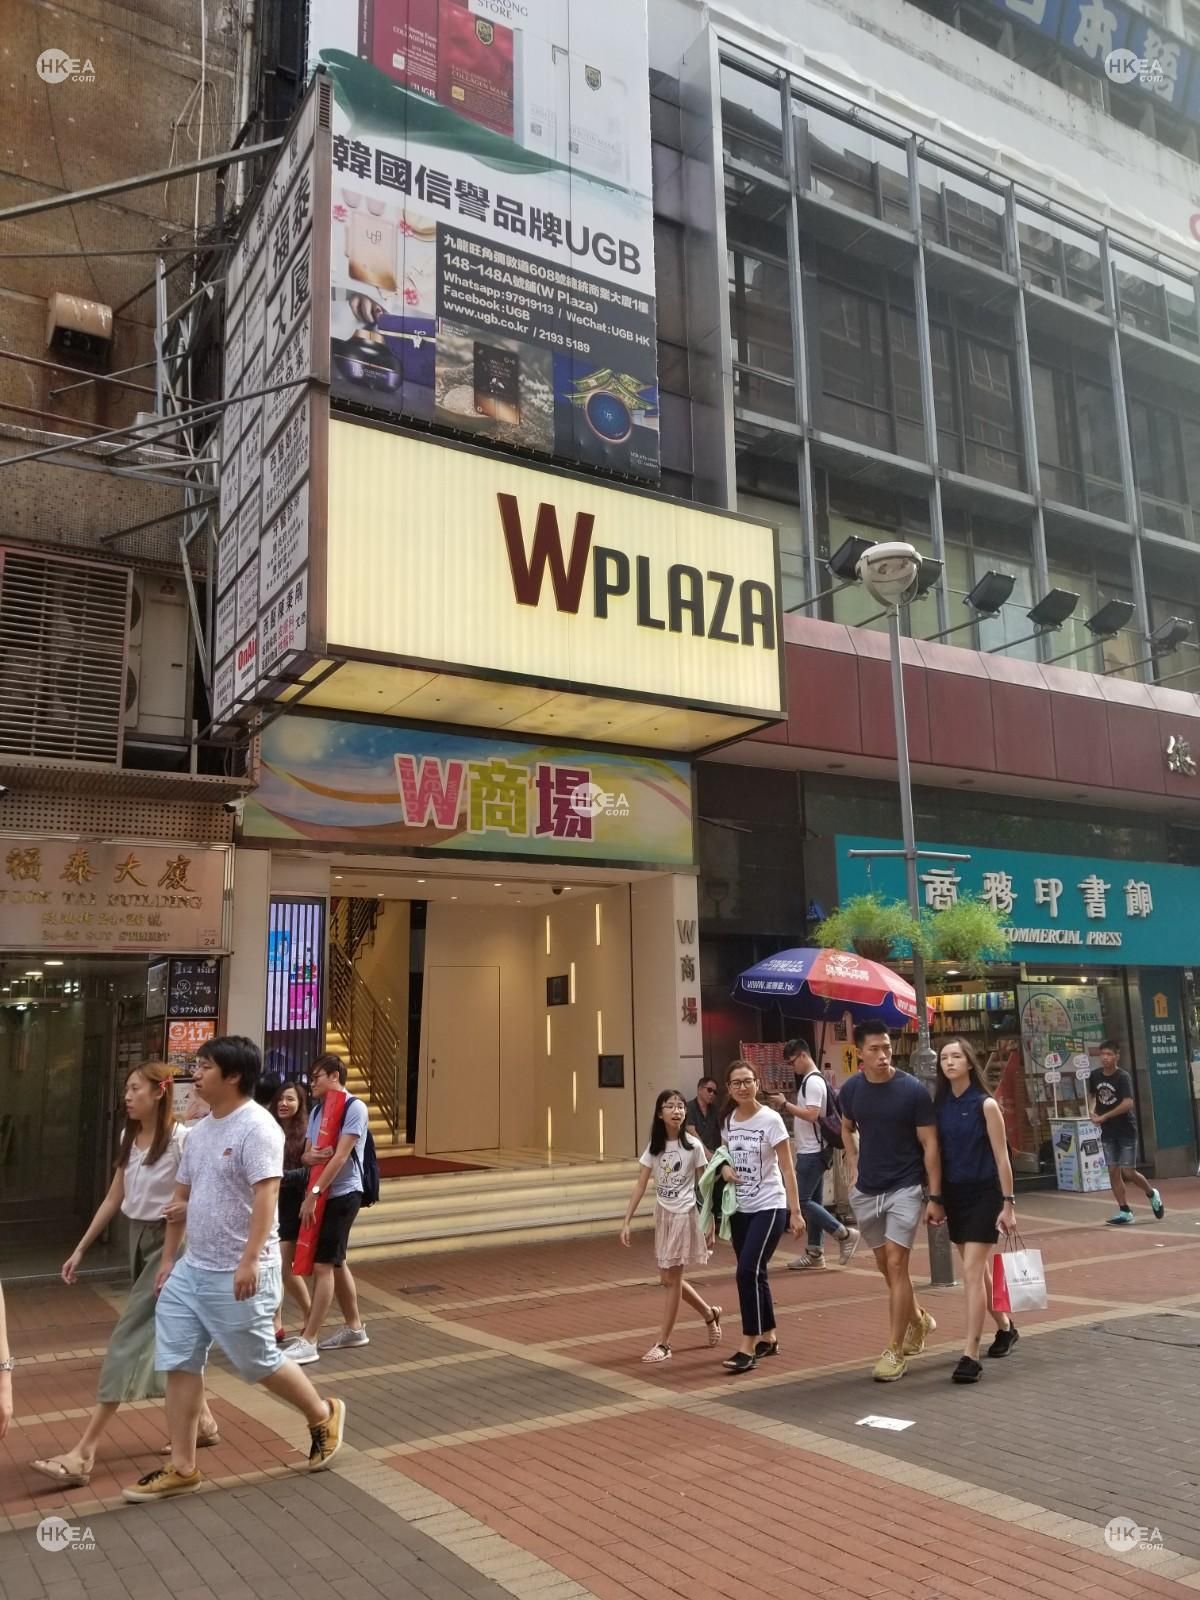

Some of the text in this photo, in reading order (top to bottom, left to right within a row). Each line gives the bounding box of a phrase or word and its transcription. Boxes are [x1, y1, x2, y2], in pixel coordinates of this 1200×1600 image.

[272, 170, 311, 279] 福泰
[332, 134, 642, 275] 韓國信譽品牌UGB
[272, 249, 311, 357] 大廈
[443, 285, 530, 321] Facebook:UGB
[443, 301, 529, 334] www.ugb.co.kr
[538, 329, 564, 345] 2193
[565, 337, 590, 353] 5189
[557, 290, 598, 315] Plaza)
[635, 333, 650, 347] HK
[593, 545, 776, 650] PLAZA
[394, 753, 594, 843] W商場
[204, 938, 215, 946] 24
[1087, 931, 1122, 946] PRESS
